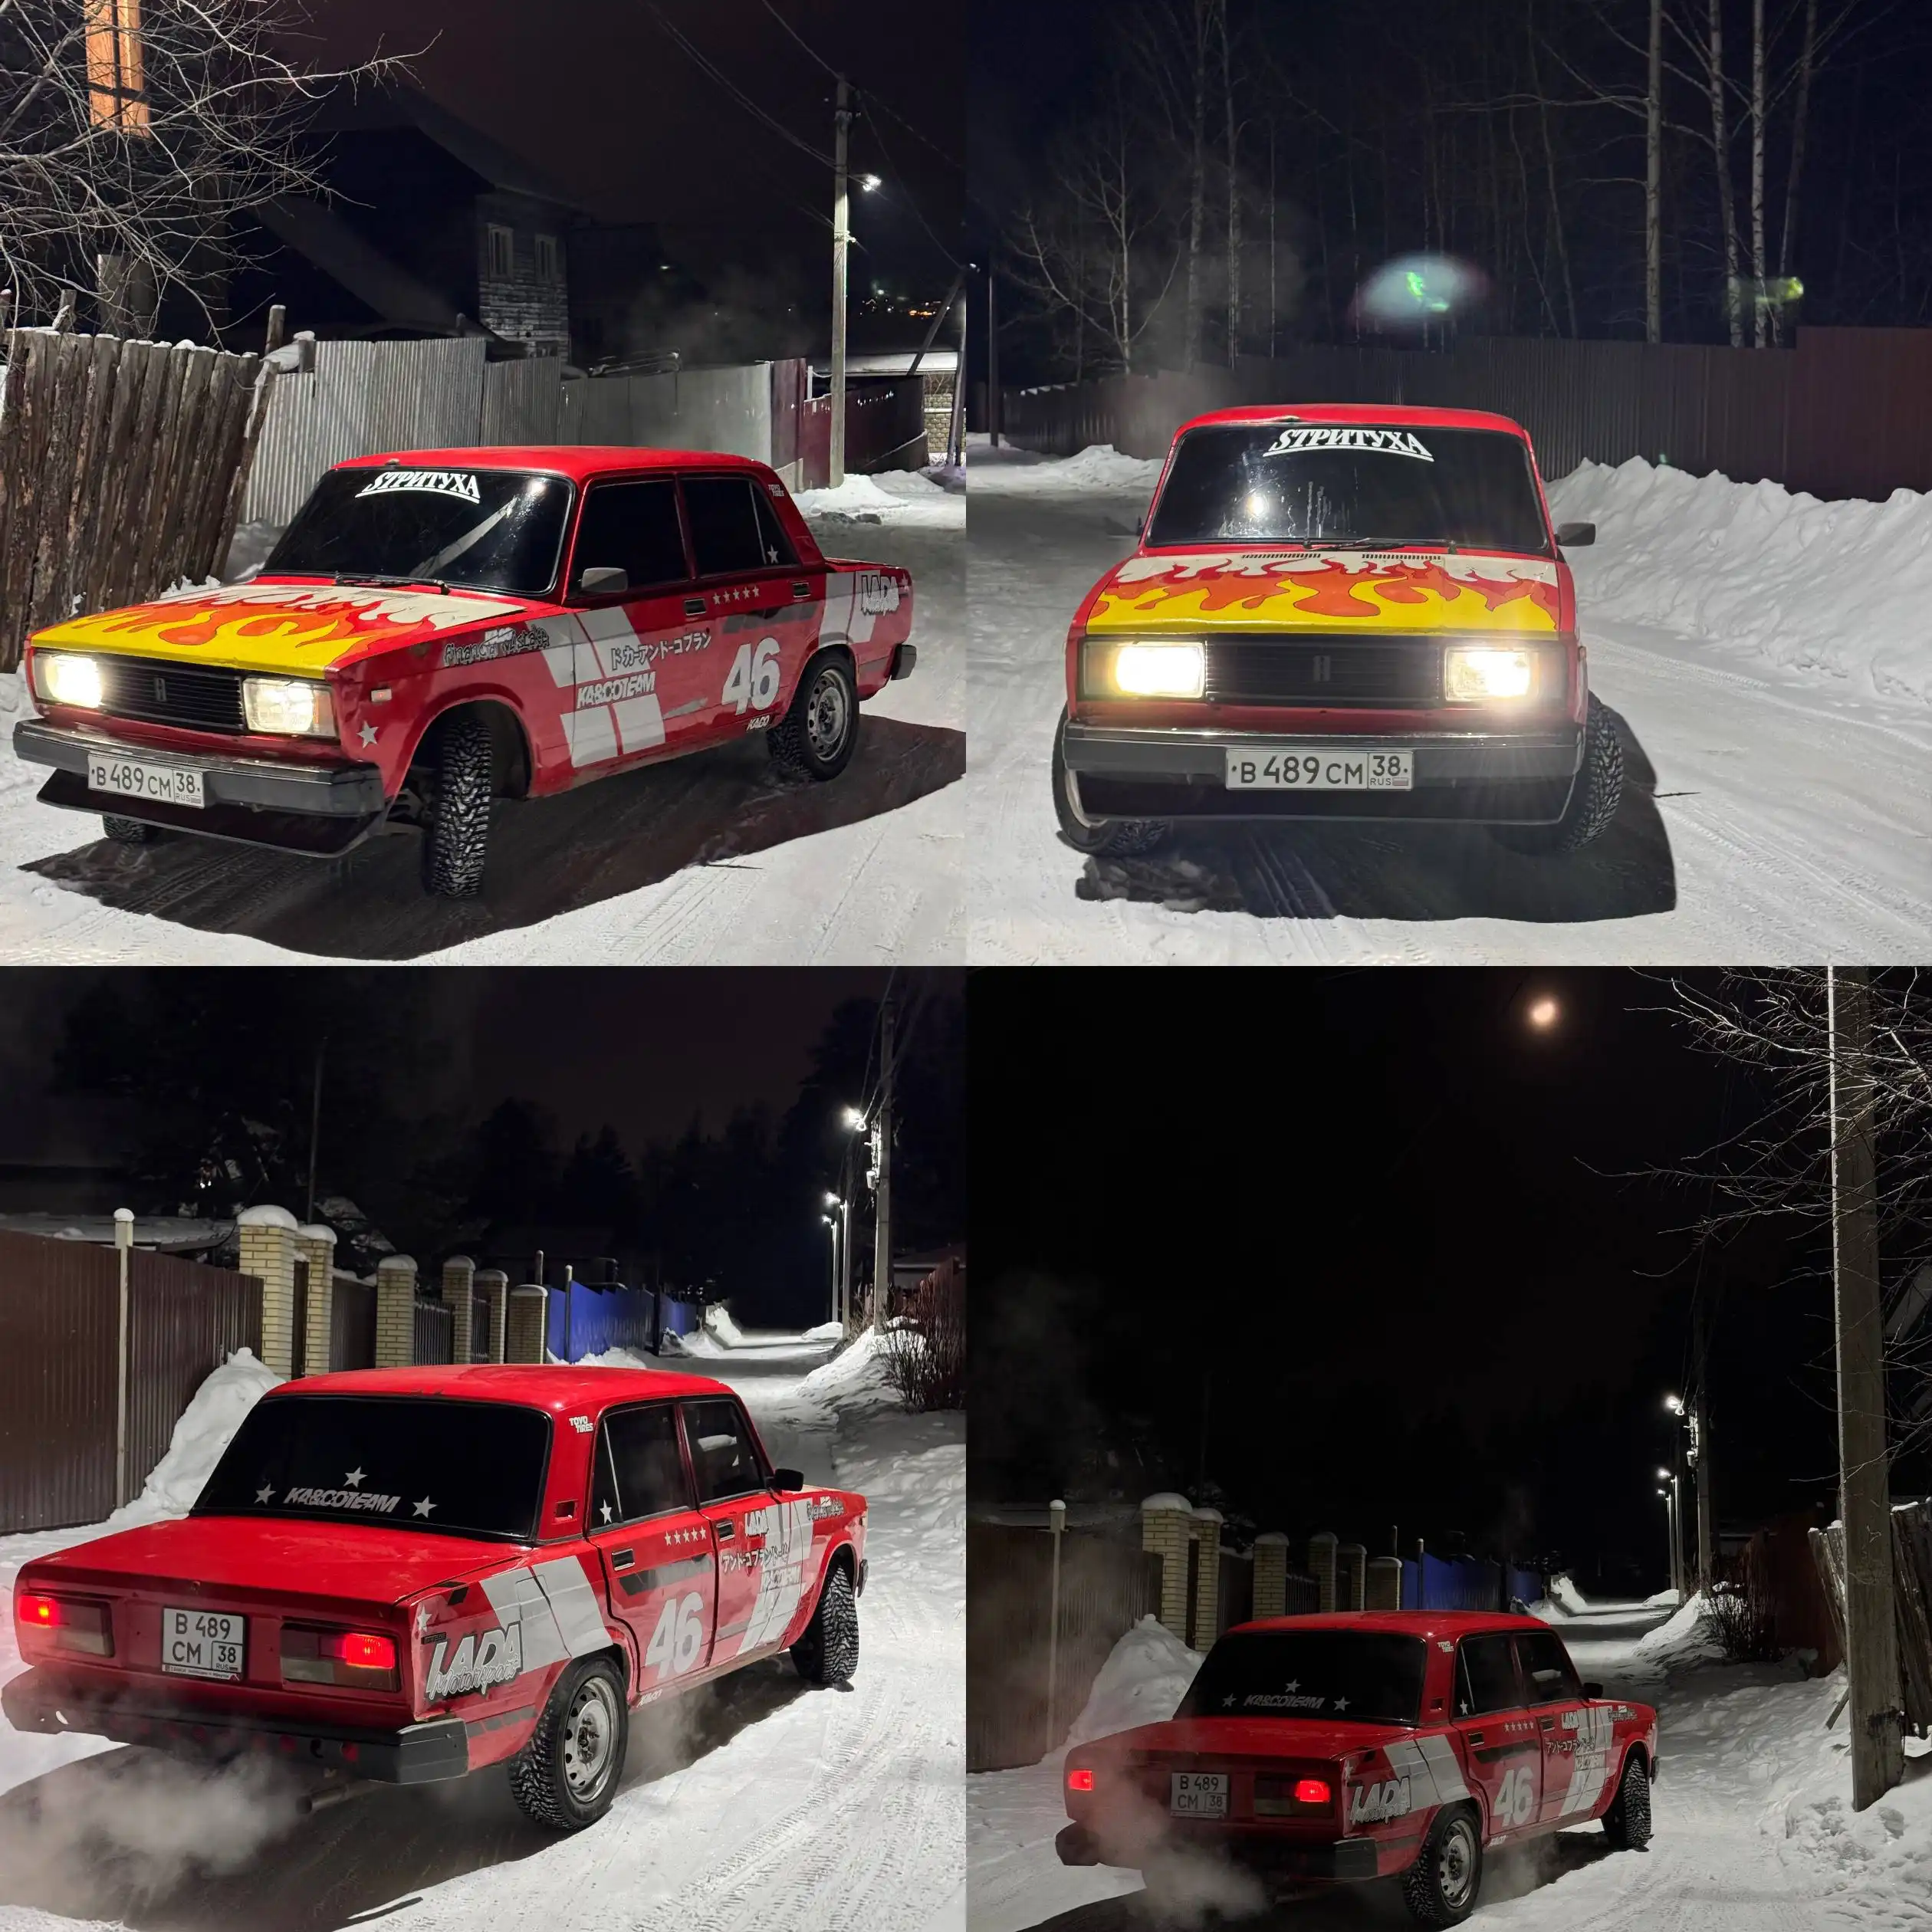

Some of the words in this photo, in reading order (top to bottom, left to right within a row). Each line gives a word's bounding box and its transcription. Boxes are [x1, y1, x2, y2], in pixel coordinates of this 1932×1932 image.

[721, 636, 780, 715] 46
[110, 764, 144, 793] 489
[176, 772, 196, 794] 38
[1263, 755, 1320, 784] 489
[1372, 755, 1401, 777] 38
[1369, 777, 1392, 786] RUS
[175, 793, 191, 803] RUS
[195, 1615, 231, 1640] 489
[644, 1591, 704, 1680] 46
[217, 1644, 237, 1664] 38
[426, 1621, 523, 1693] LADA
[1194, 1775, 1219, 1791] 489
[1493, 1765, 1533, 1827] 46
[1210, 1795, 1223, 1808] 38
